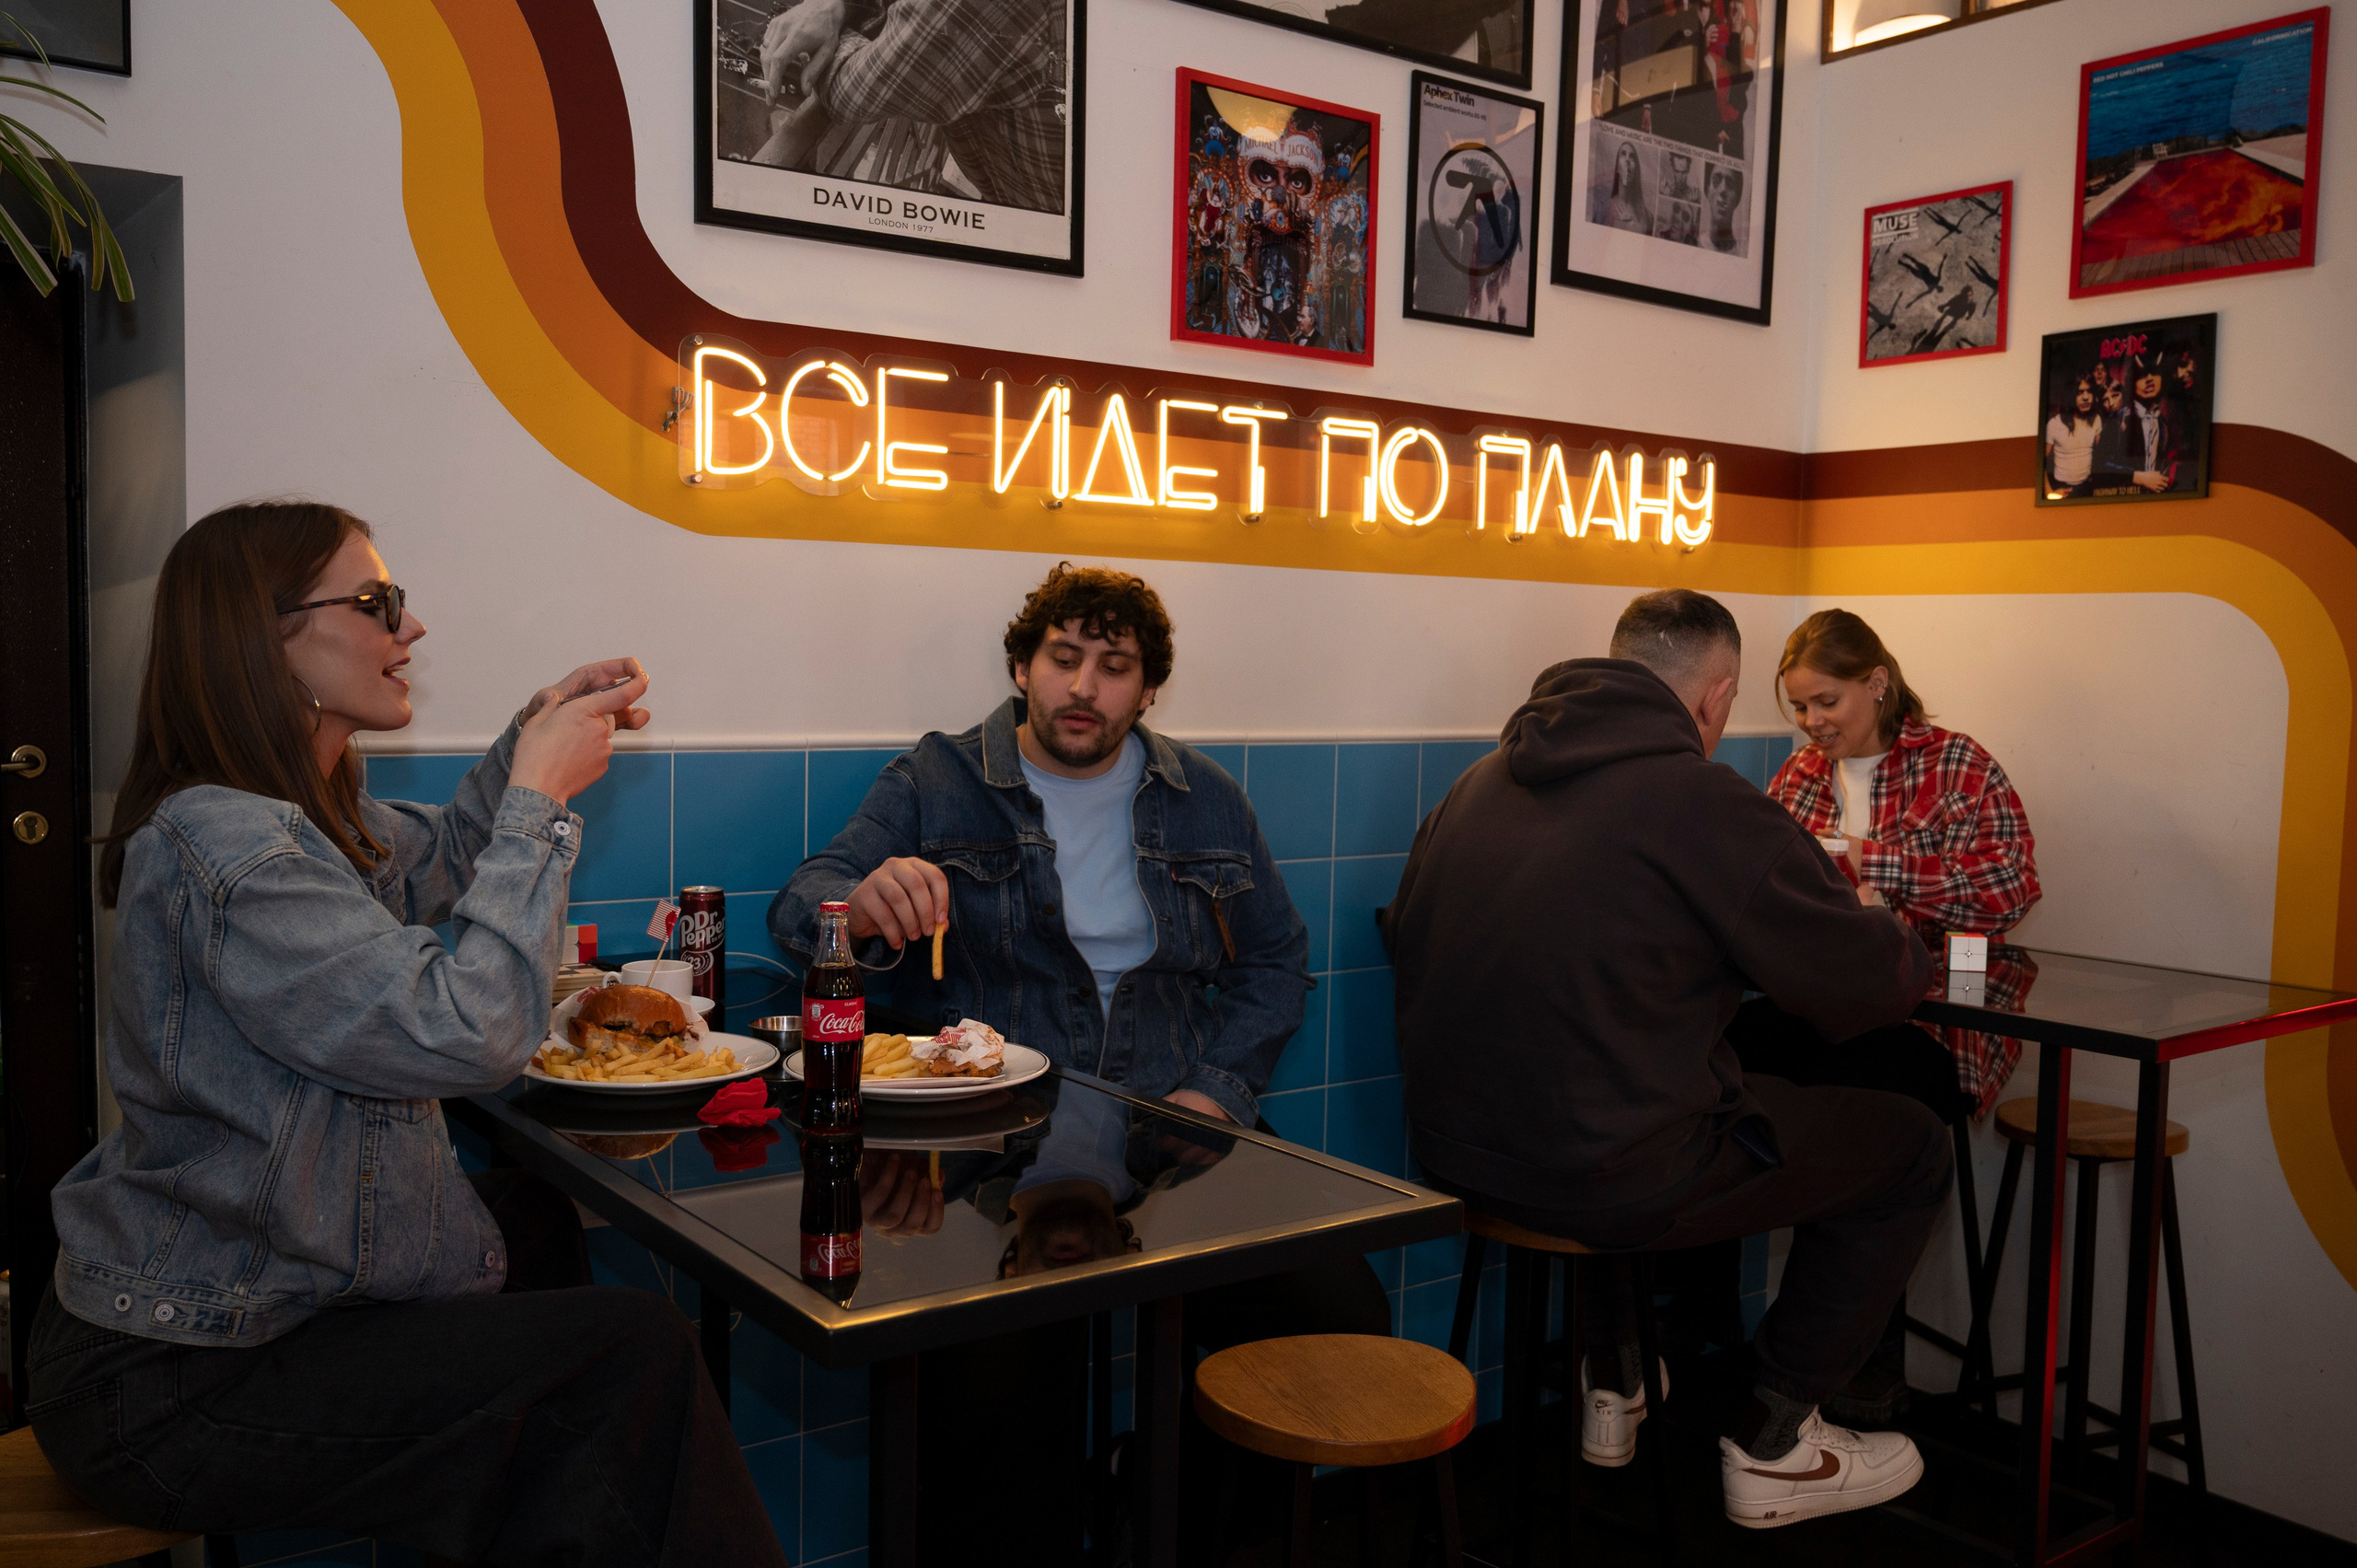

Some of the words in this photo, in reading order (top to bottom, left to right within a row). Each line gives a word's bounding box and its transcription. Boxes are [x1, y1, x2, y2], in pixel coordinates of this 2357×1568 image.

[1423, 84, 1453, 100] Aphex
[1453, 91, 1475, 107] Twin
[1422, 99, 1443, 110] Selected
[1442, 104, 1460, 113] ambient
[1460, 110, 1473, 118] works
[1244, 134, 1278, 155] MICHAEL
[1287, 144, 1318, 165] JACKSON
[813, 187, 893, 215] DAVID
[902, 201, 986, 230] BOWIE
[868, 216, 909, 229] LONDON
[911, 224, 934, 233] 1977
[1873, 213, 1918, 234] MUSE
[693, 345, 949, 492] ВСЕ
[992, 378, 1289, 515] ИДЕТ
[1318, 415, 1450, 527] ПО
[1476, 434, 1715, 546] ПЛАНУ
[694, 911, 718, 931] Dr
[687, 957, 702, 970] 23
[1763, 1510, 1777, 1520] AIR
